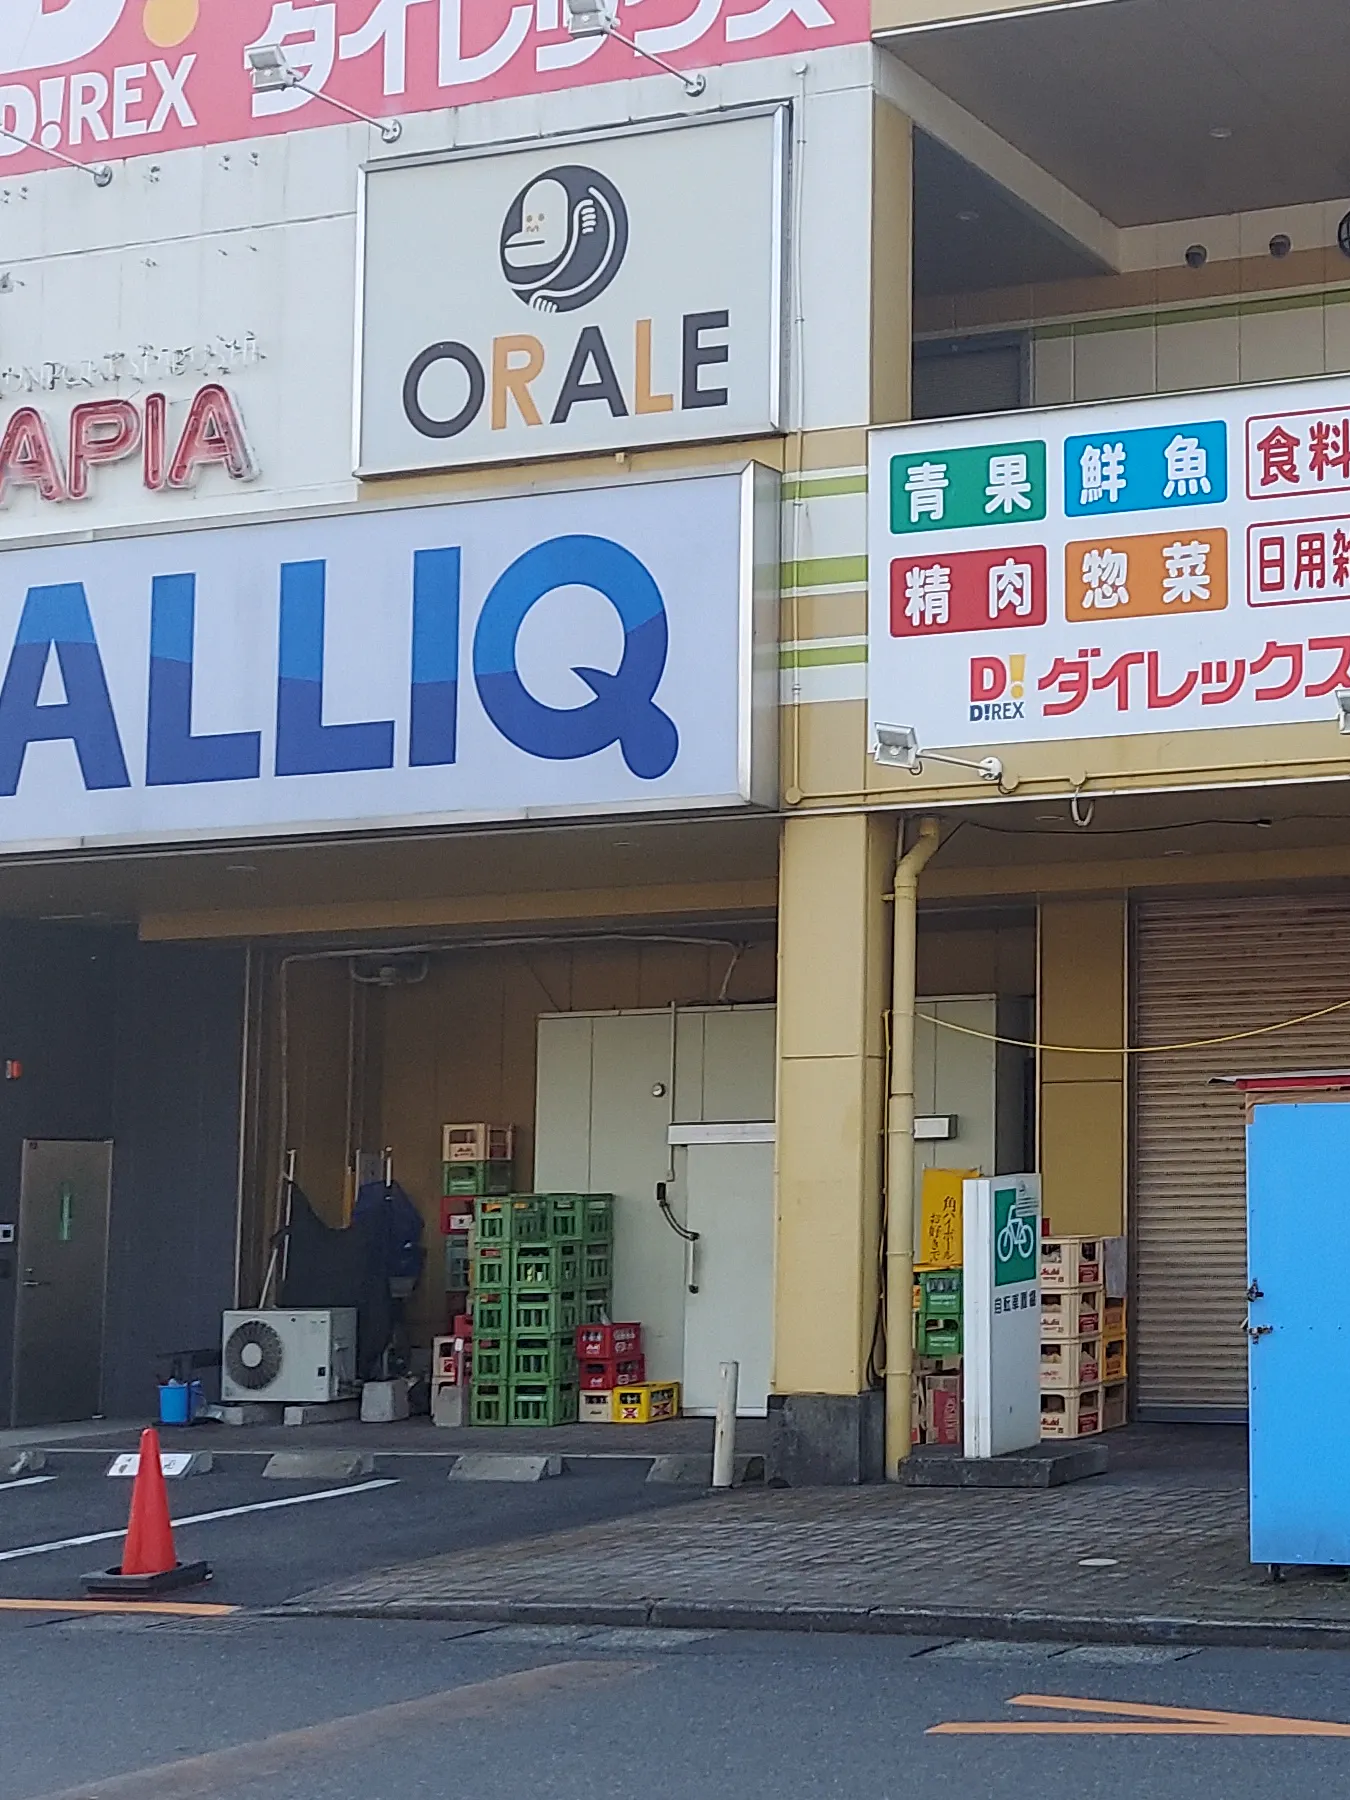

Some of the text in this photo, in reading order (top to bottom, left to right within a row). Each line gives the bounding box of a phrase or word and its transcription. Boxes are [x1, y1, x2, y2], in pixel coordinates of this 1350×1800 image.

[403, 310, 729, 438] ORALE
[904, 453, 1032, 522] 青果
[1079, 433, 1212, 505] 鮮魚
[904, 557, 1032, 628] 精肉
[1081, 541, 1212, 610] 惣菜
[0, 534, 679, 797] ALLIQ
